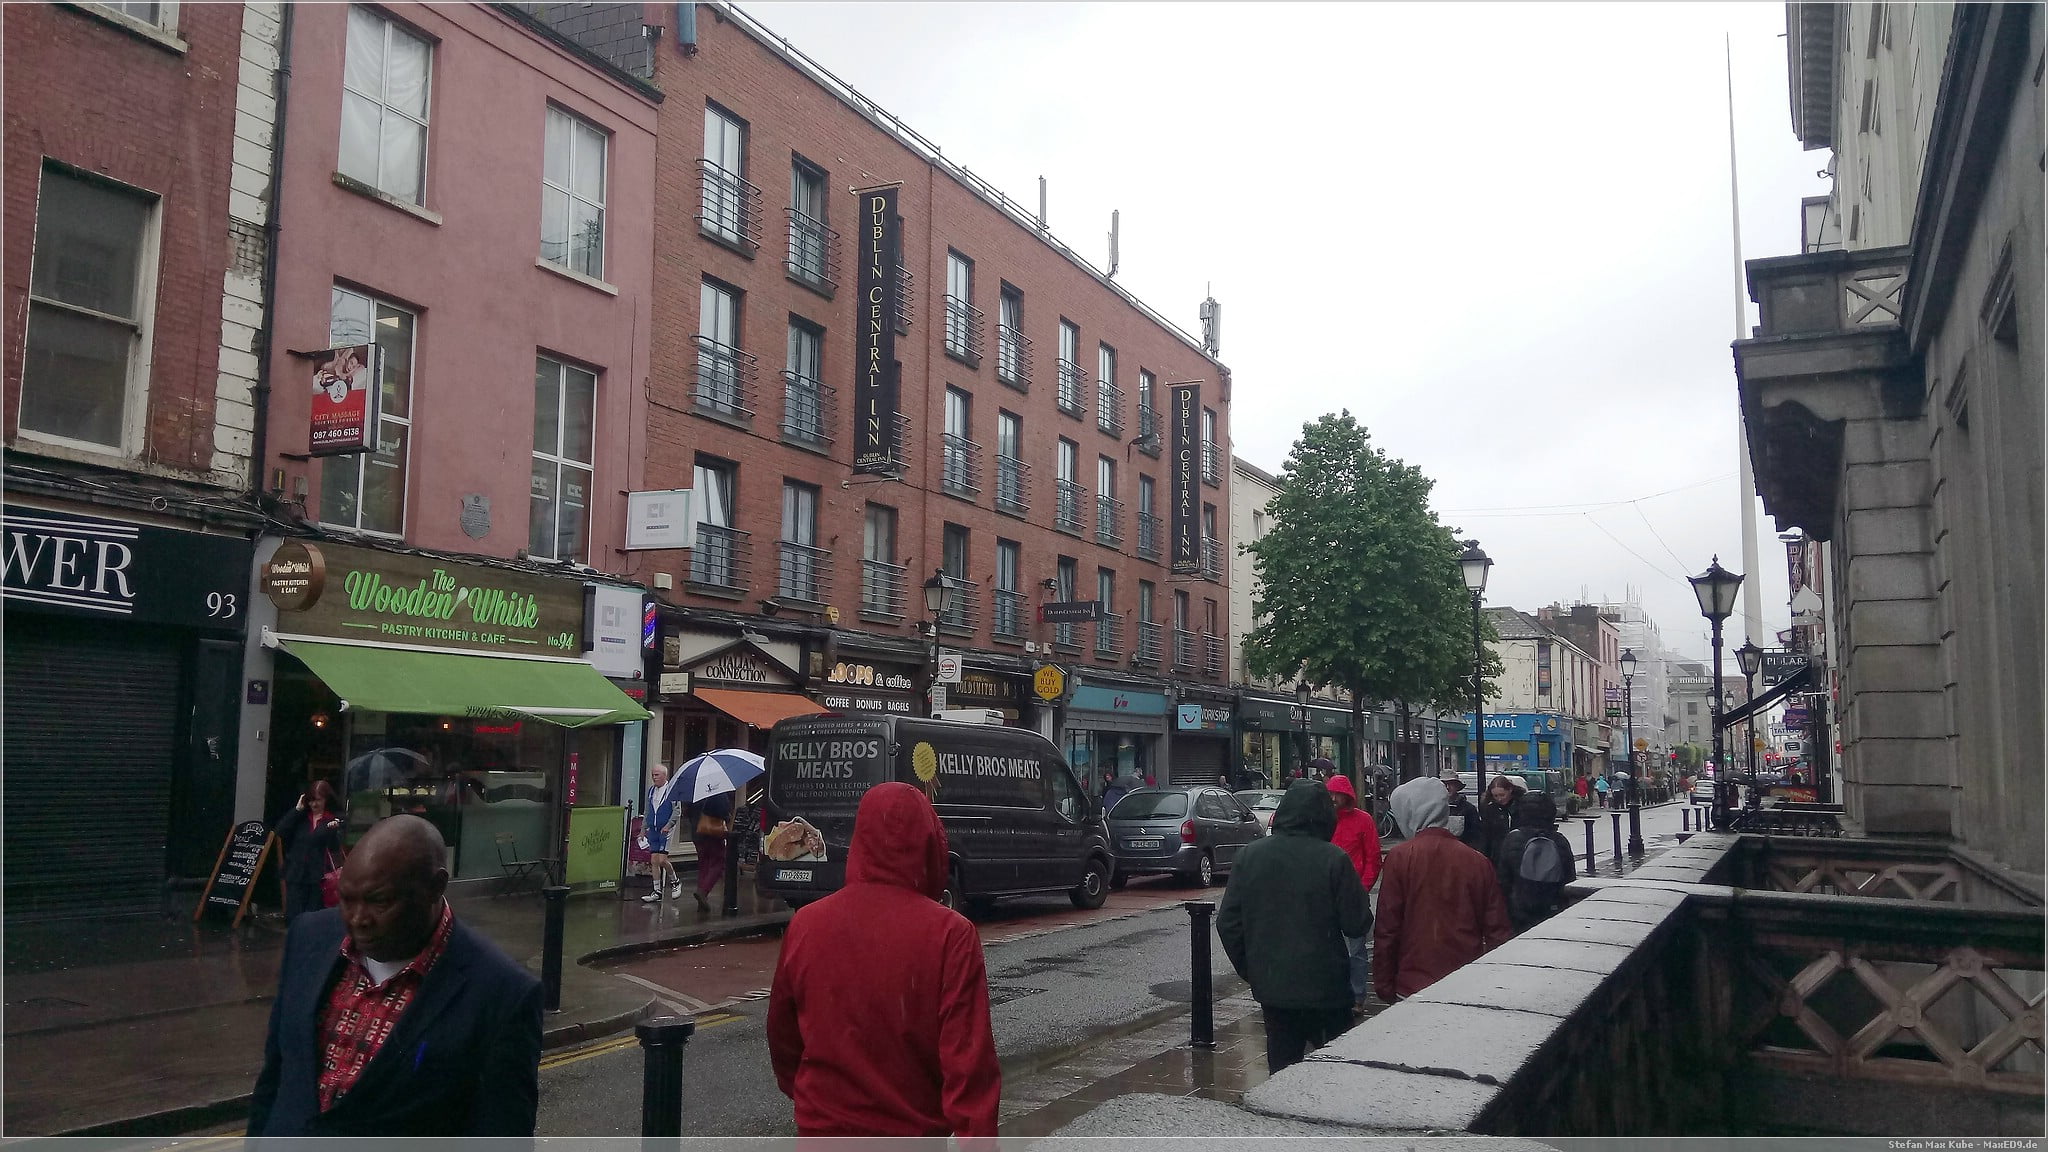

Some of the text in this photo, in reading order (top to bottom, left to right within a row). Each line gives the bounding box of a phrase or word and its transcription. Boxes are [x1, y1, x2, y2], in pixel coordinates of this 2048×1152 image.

[868, 196, 886, 446] DUBLIN CENTRAL INN
[1180, 390, 1192, 445] DUBLIN
[1180, 449, 1191, 517] CENTRAL
[1181, 524, 1190, 556] INN
[432, 568, 456, 591] The
[206, 591, 236, 619] 93
[344, 570, 540, 630] Wooden Whisk
[381, 622, 422, 638] PASTRY
[425, 628, 469, 642] KITCHEN
[471, 632, 478, 642] &
[481, 633, 506, 645] CAFE
[717, 654, 756, 670] ITALIAN
[705, 665, 767, 682] CONNECTION
[875, 674, 884, 687] &
[885, 676, 912, 690] coffee
[1040, 677, 1056, 686] BUY
[1043, 670, 1055, 678] WE
[1037, 685, 1060, 694] GOLD
[825, 695, 910, 713] COFFEE DONUTS BAGELS
[1483, 719, 1517, 728] RAVEL
[779, 740, 878, 760] KELLY BROS
[796, 760, 854, 779] MEATS
[938, 752, 974, 776] KELLY
[976, 755, 1007, 778] BROS
[1008, 757, 1041, 780] MEATS
[568, 761, 580, 804] MAS
